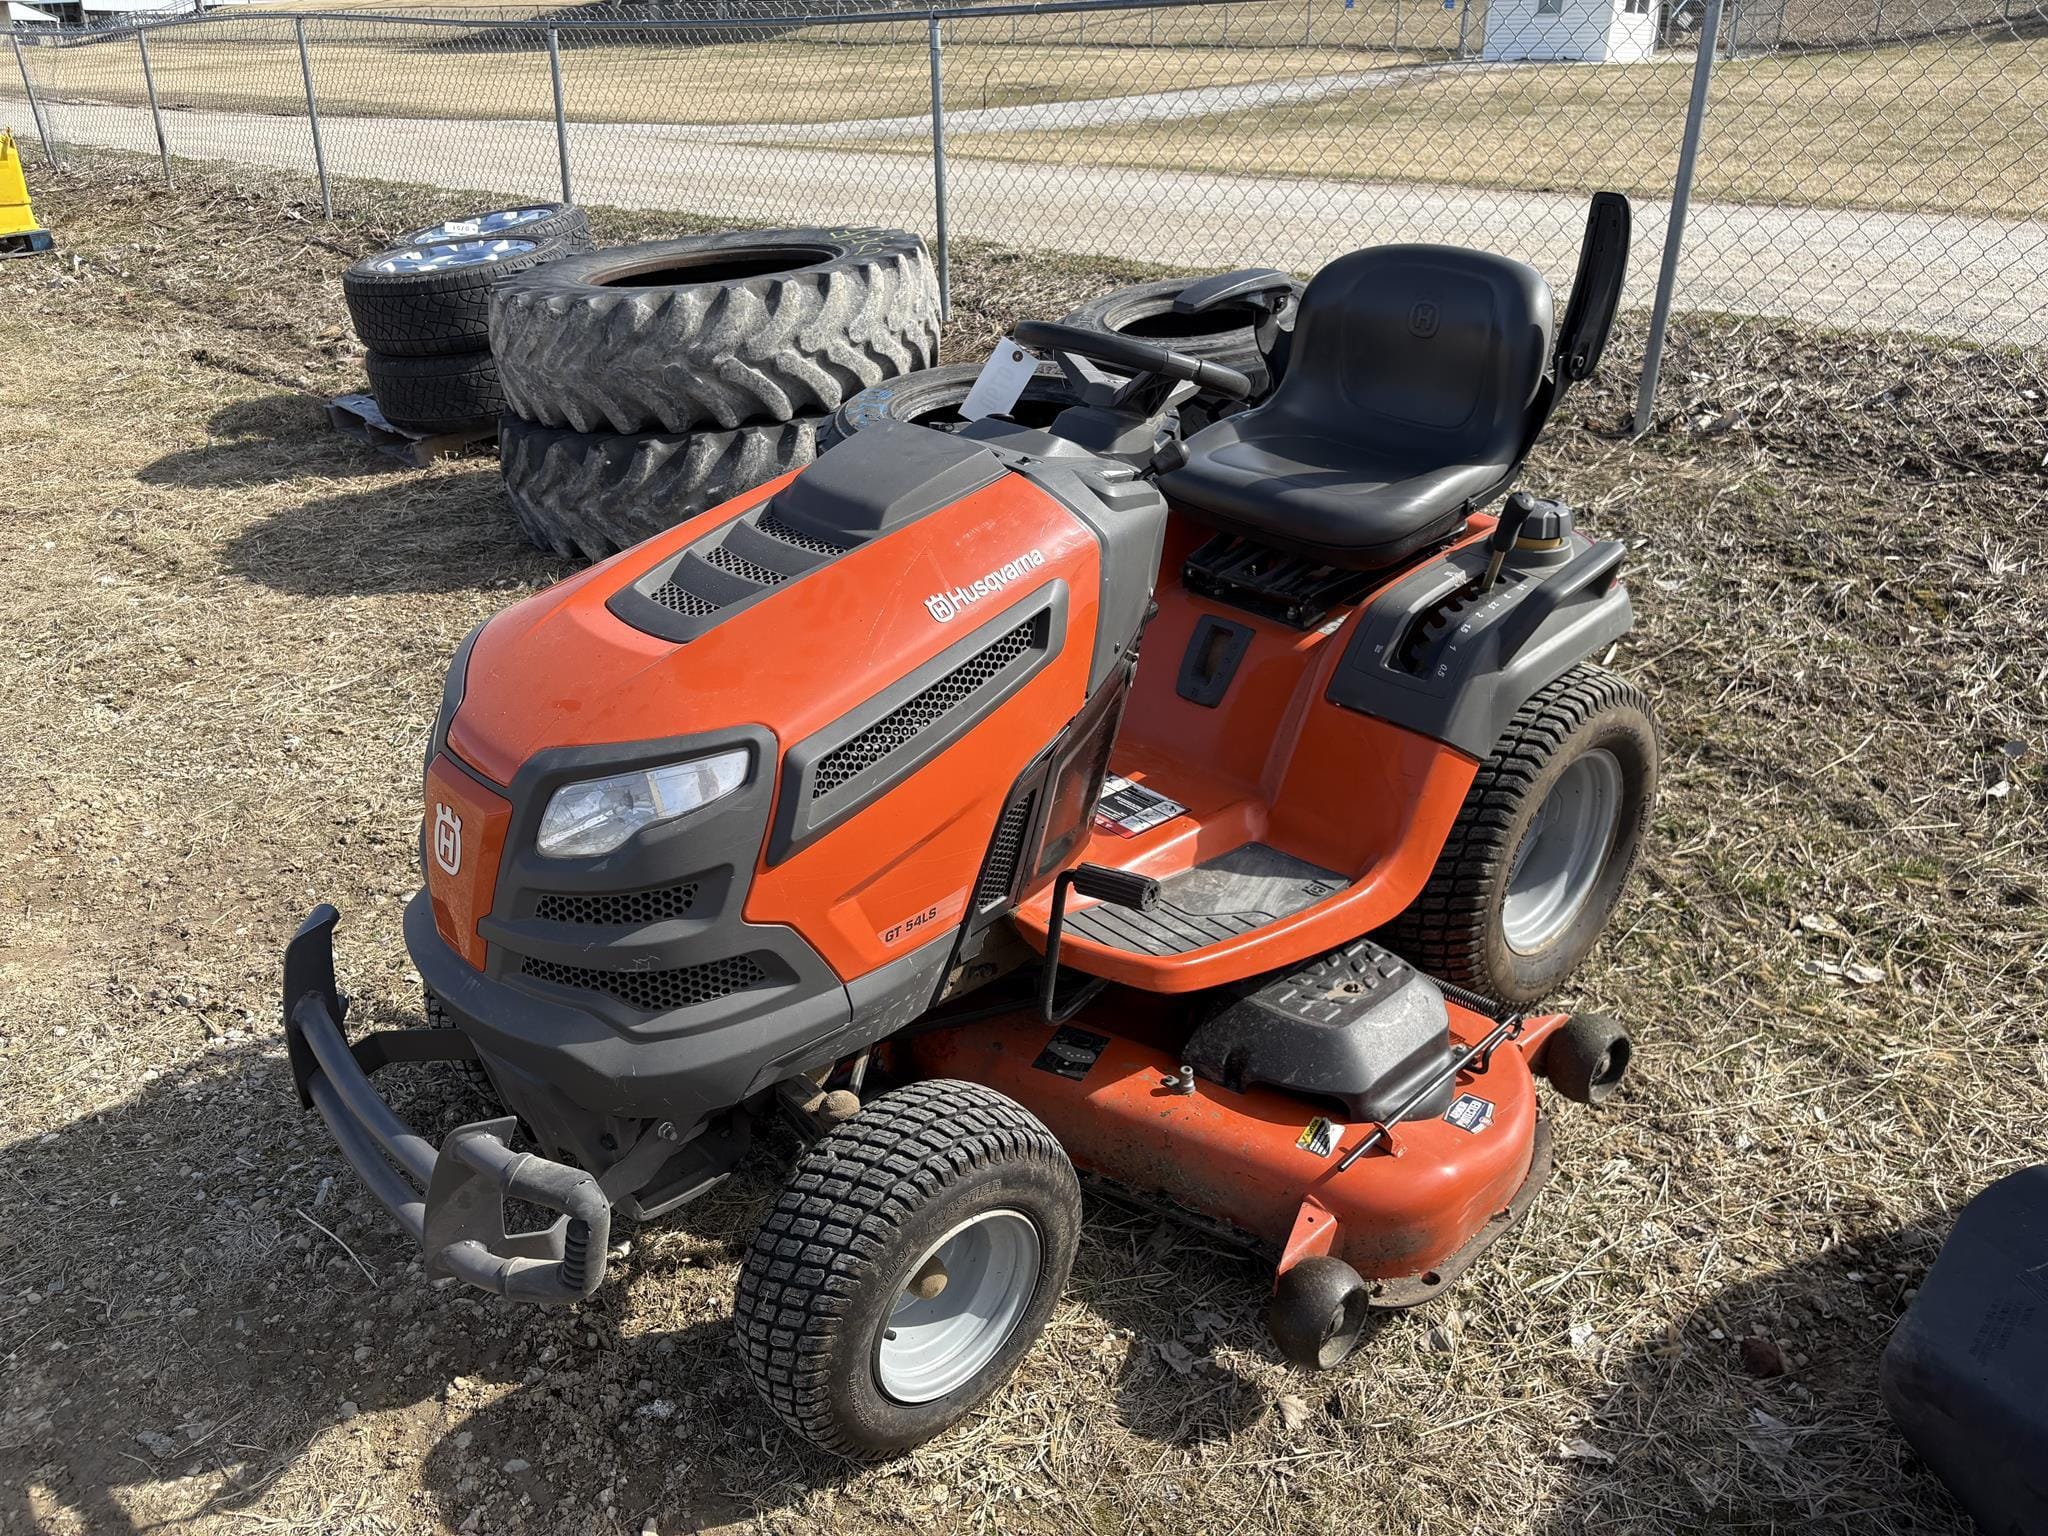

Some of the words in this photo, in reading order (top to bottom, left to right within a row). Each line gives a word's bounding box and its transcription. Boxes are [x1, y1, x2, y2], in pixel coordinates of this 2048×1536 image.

[949, 549, 1047, 612] Husqvarna
[1449, 644, 1457, 652] 1
[884, 925, 902, 942] GT
[905, 907, 937, 932] 54LS
